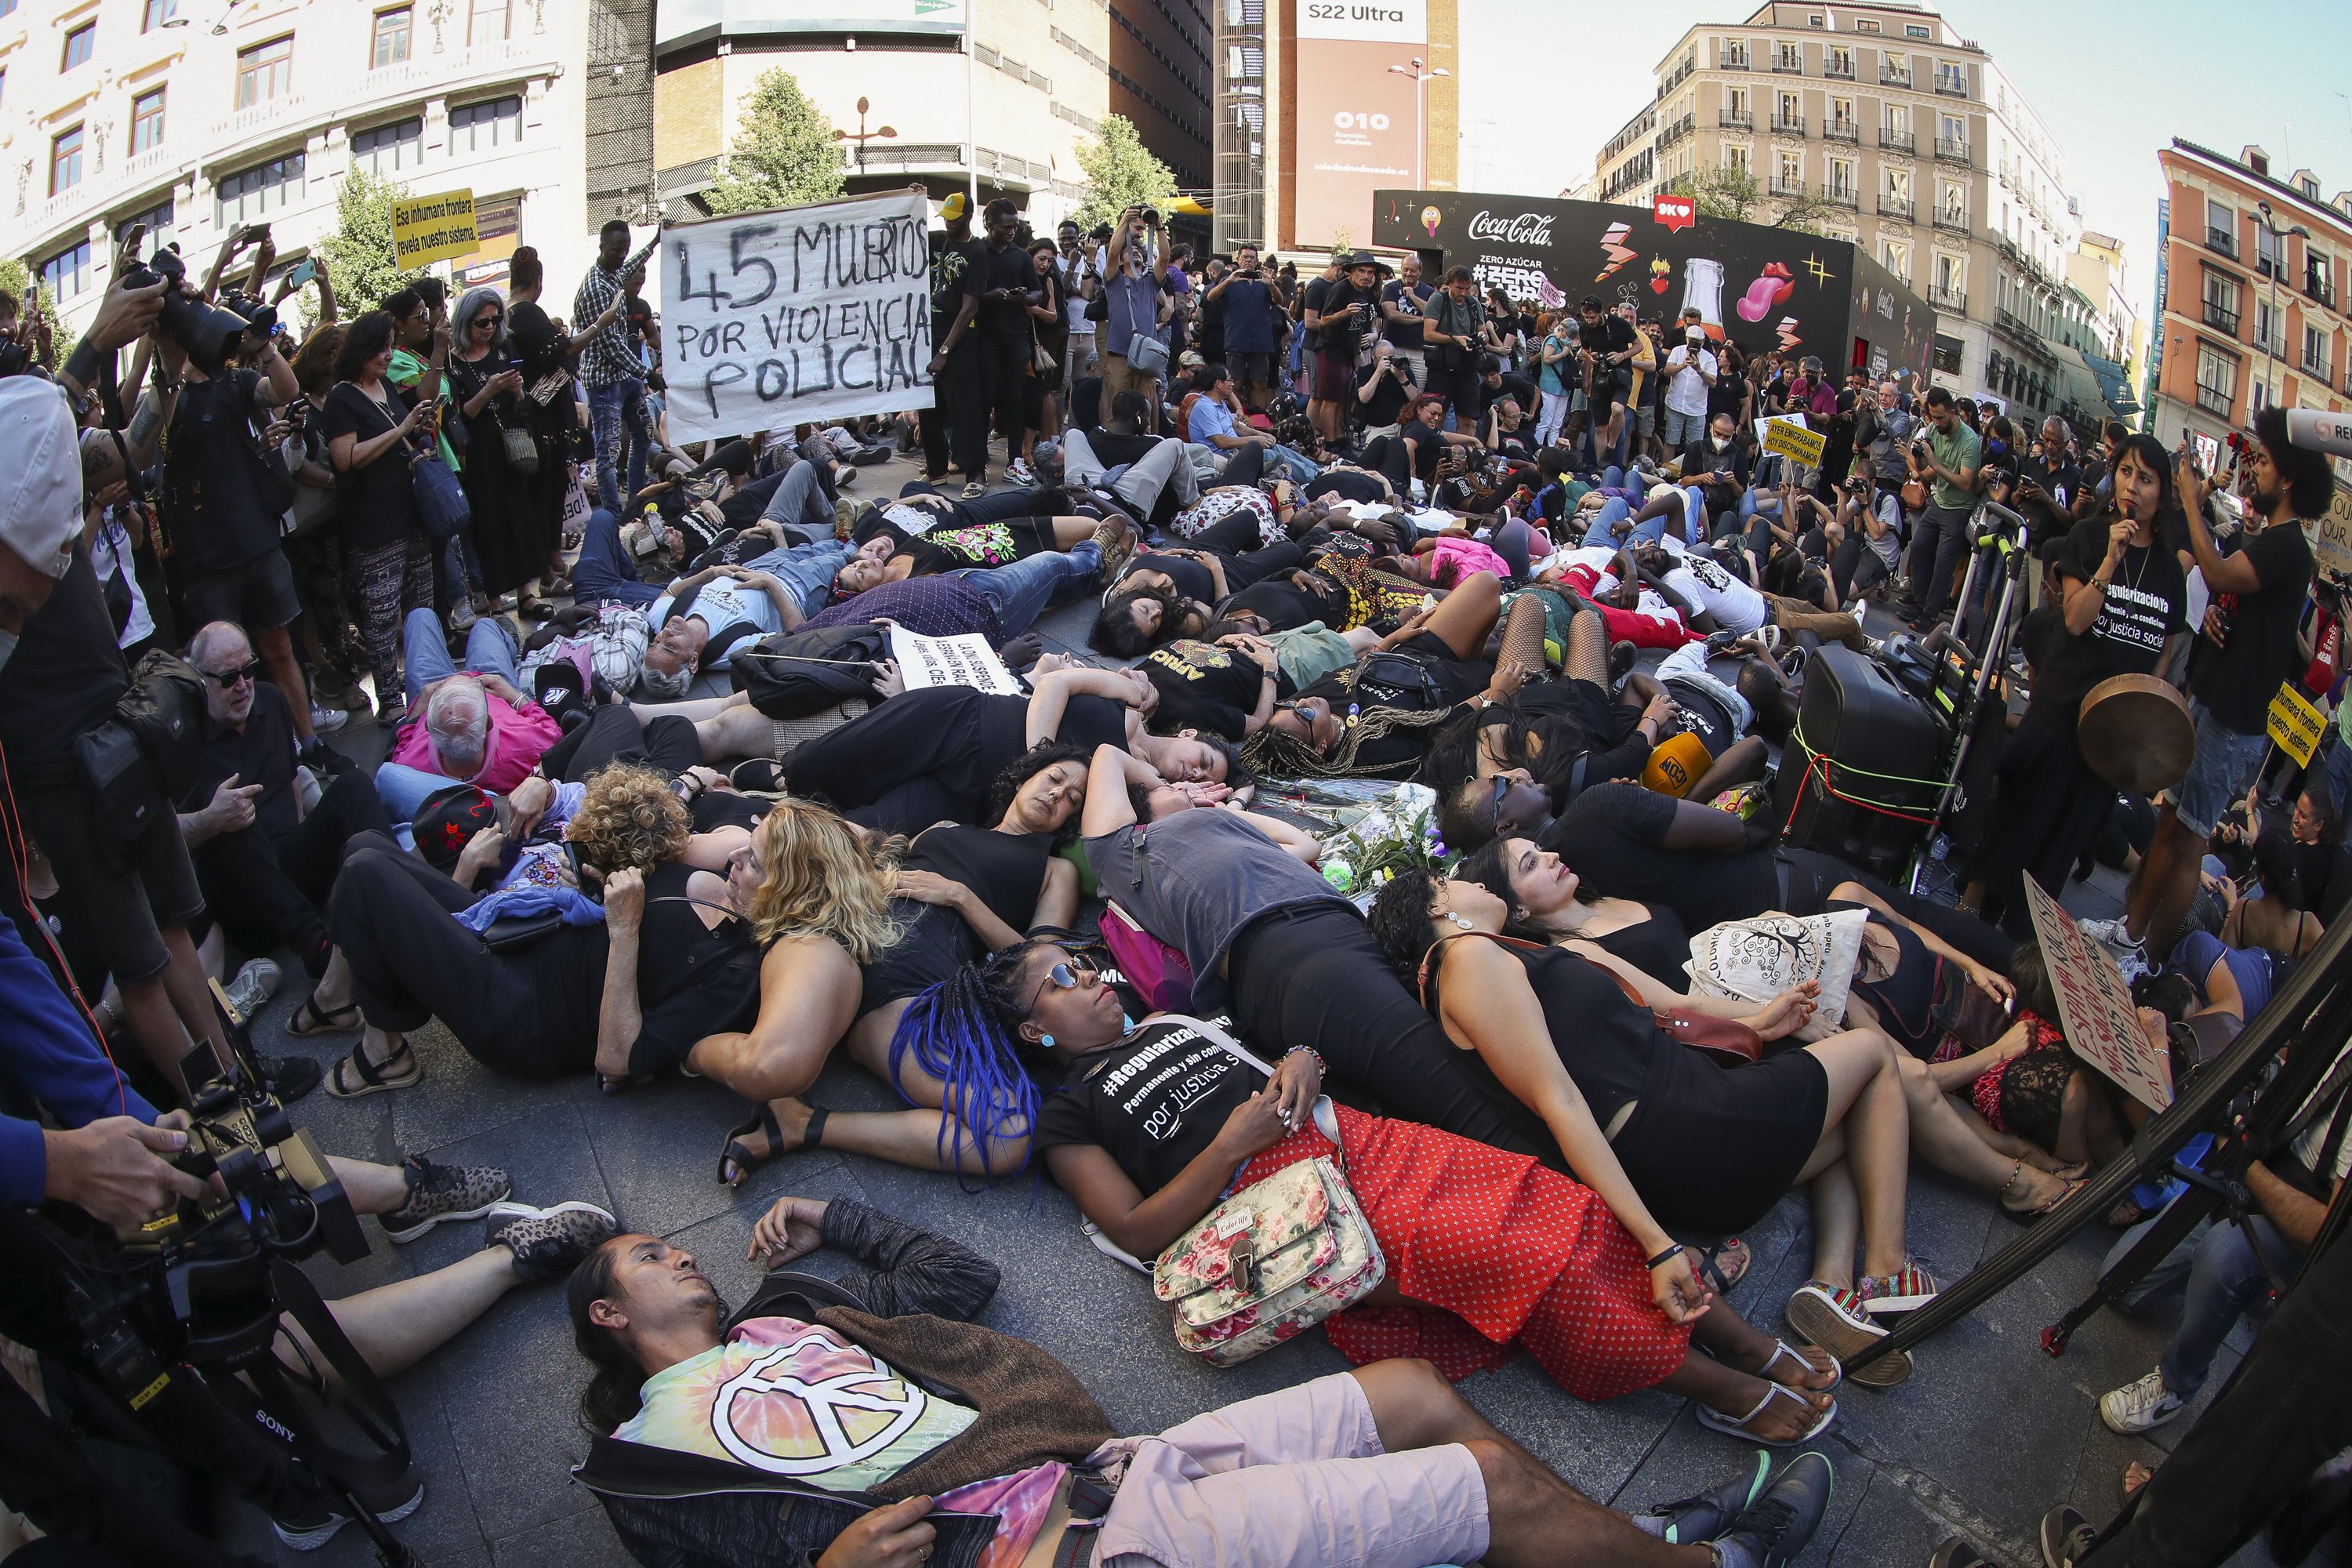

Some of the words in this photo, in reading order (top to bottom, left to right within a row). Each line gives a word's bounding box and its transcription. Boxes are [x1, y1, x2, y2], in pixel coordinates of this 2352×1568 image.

[1308, 4, 1345, 20] S22
[1352, 6, 1403, 22] Ultra
[1334, 111, 1390, 131] 010
[1334, 131, 1367, 140] Atención
[1314, 162, 1409, 176] soledadnodeseada.es
[396, 207, 410, 227] Esa
[410, 202, 445, 224] inhumana
[445, 198, 472, 218] frontera
[1658, 202, 1677, 216] 9K
[397, 233, 420, 256] revela
[420, 228, 448, 251] nuestro
[448, 225, 476, 244] sistema.
[677, 224, 778, 312] 45
[793, 214, 929, 293] MUERTOS
[1479, 255, 1504, 264] ZERO
[1504, 257, 1542, 269] AZÚCAR
[677, 321, 747, 362] POR
[761, 292, 932, 350] VIOLENCIA
[705, 342, 935, 419] POLICIAL
[1766, 436, 1779, 446] HOY
[1778, 440, 1818, 463] DISCRIMINAMOS.
[1770, 424, 1785, 436] AYER
[1784, 428, 1822, 452] EMIGRÁBAMOS,
[1332, 536, 1359, 550] GUCCI
[2323, 518, 2347, 547] OUR
[2107, 619, 2141, 641] justicia
[2143, 632, 2164, 648] social
[969, 658, 996, 690] SUSPENDE
[2274, 688, 2299, 719] nhumana
[2298, 708, 2321, 738] frontera
[2268, 713, 2290, 739] nuestro
[2288, 729, 2309, 758] sistema.
[1823, 914, 1833, 928] que
[2031, 880, 2071, 968] RACISTA
[1824, 931, 1833, 953] nada
[2054, 903, 2091, 977] ASESINA
[2081, 931, 2118, 1004] NEGRAS
[2054, 964, 2102, 1060] ESPAÑA
[2102, 960, 2154, 1066] MELILLA
[2108, 1007, 2143, 1078] VIDAS
[1123, 1065, 1181, 1115] Permanente
[1177, 1062, 1189, 1073] y
[1187, 1051, 1202, 1066] sin
[2144, 1073, 2168, 1109] EN
[1142, 1101, 1171, 1140] por
[1170, 1062, 1229, 1109] justicia
[1221, 1221, 1238, 1232] Color
[1238, 1215, 1248, 1225] life
[226, 1343, 263, 1362] SONY
[256, 1409, 296, 1443] SONY
